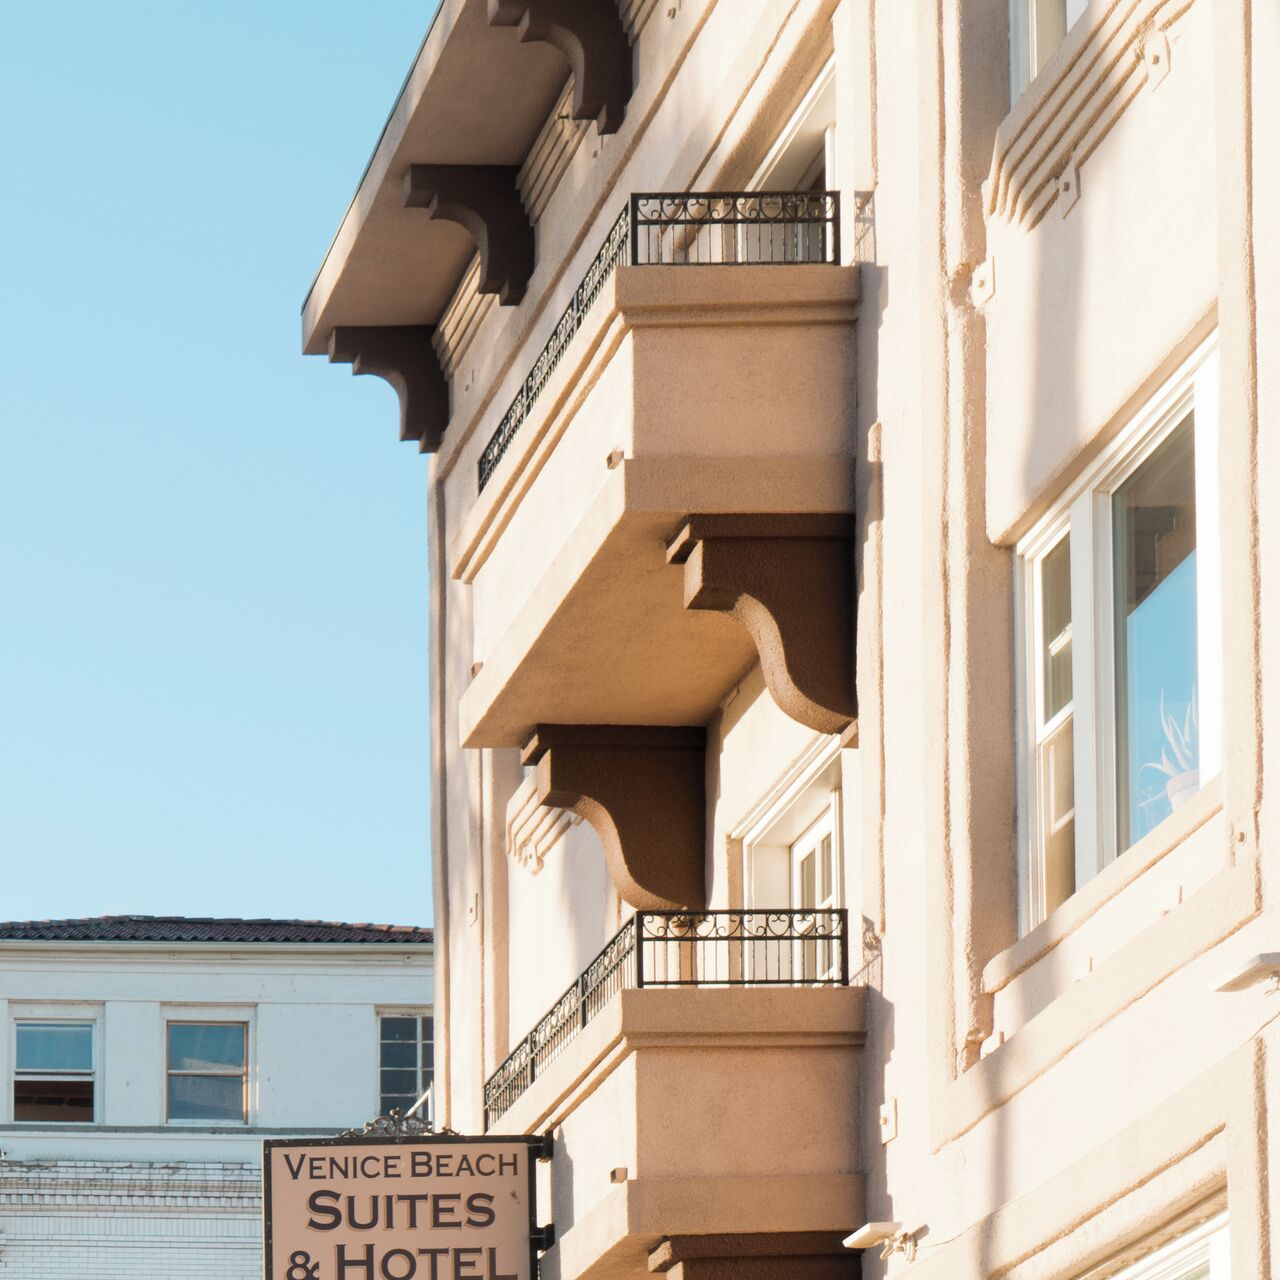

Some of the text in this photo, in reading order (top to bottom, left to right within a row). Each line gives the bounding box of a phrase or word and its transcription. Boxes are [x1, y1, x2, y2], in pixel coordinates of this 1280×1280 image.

[284, 1151, 519, 1180] VENICE BEACH
[306, 1190, 496, 1231] SUITES
